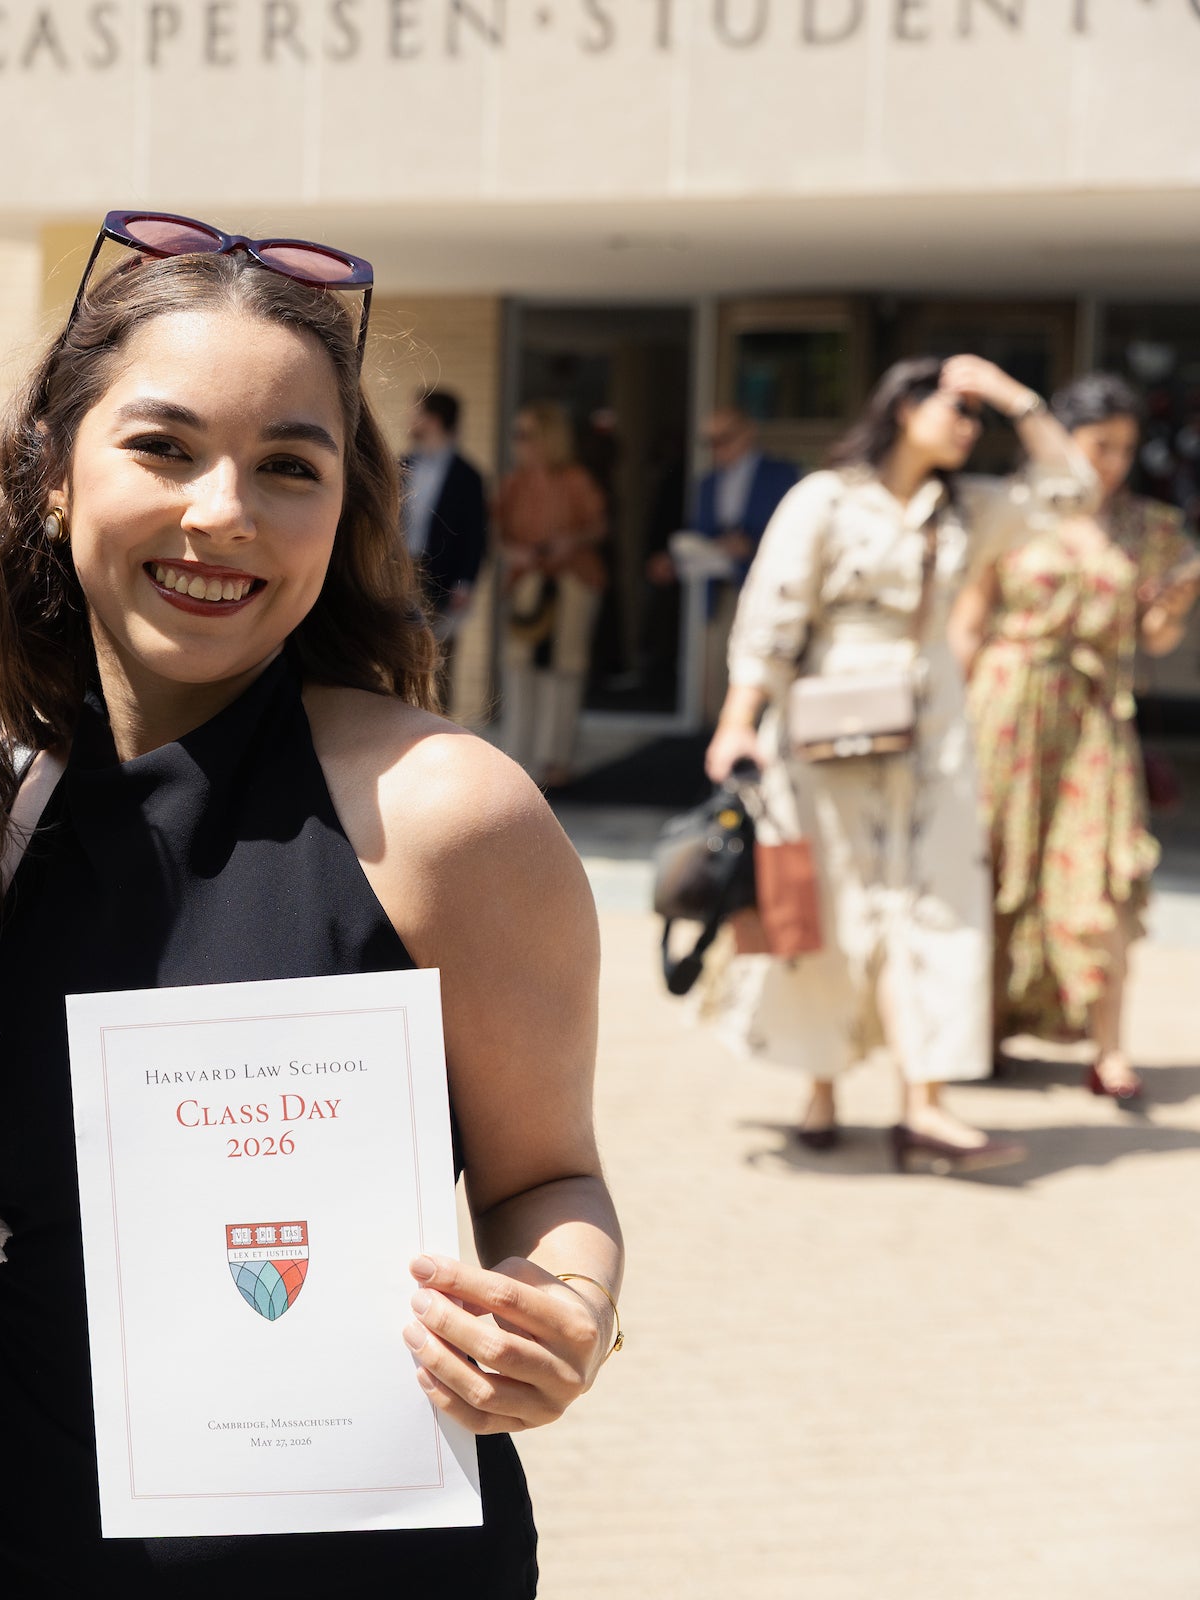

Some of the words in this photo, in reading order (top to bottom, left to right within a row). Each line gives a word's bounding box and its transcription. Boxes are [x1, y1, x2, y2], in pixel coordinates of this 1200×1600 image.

[226, 1130, 296, 1158] 2026
[275, 1439, 288, 1448] 27,
[290, 1436, 312, 1446] 2026
